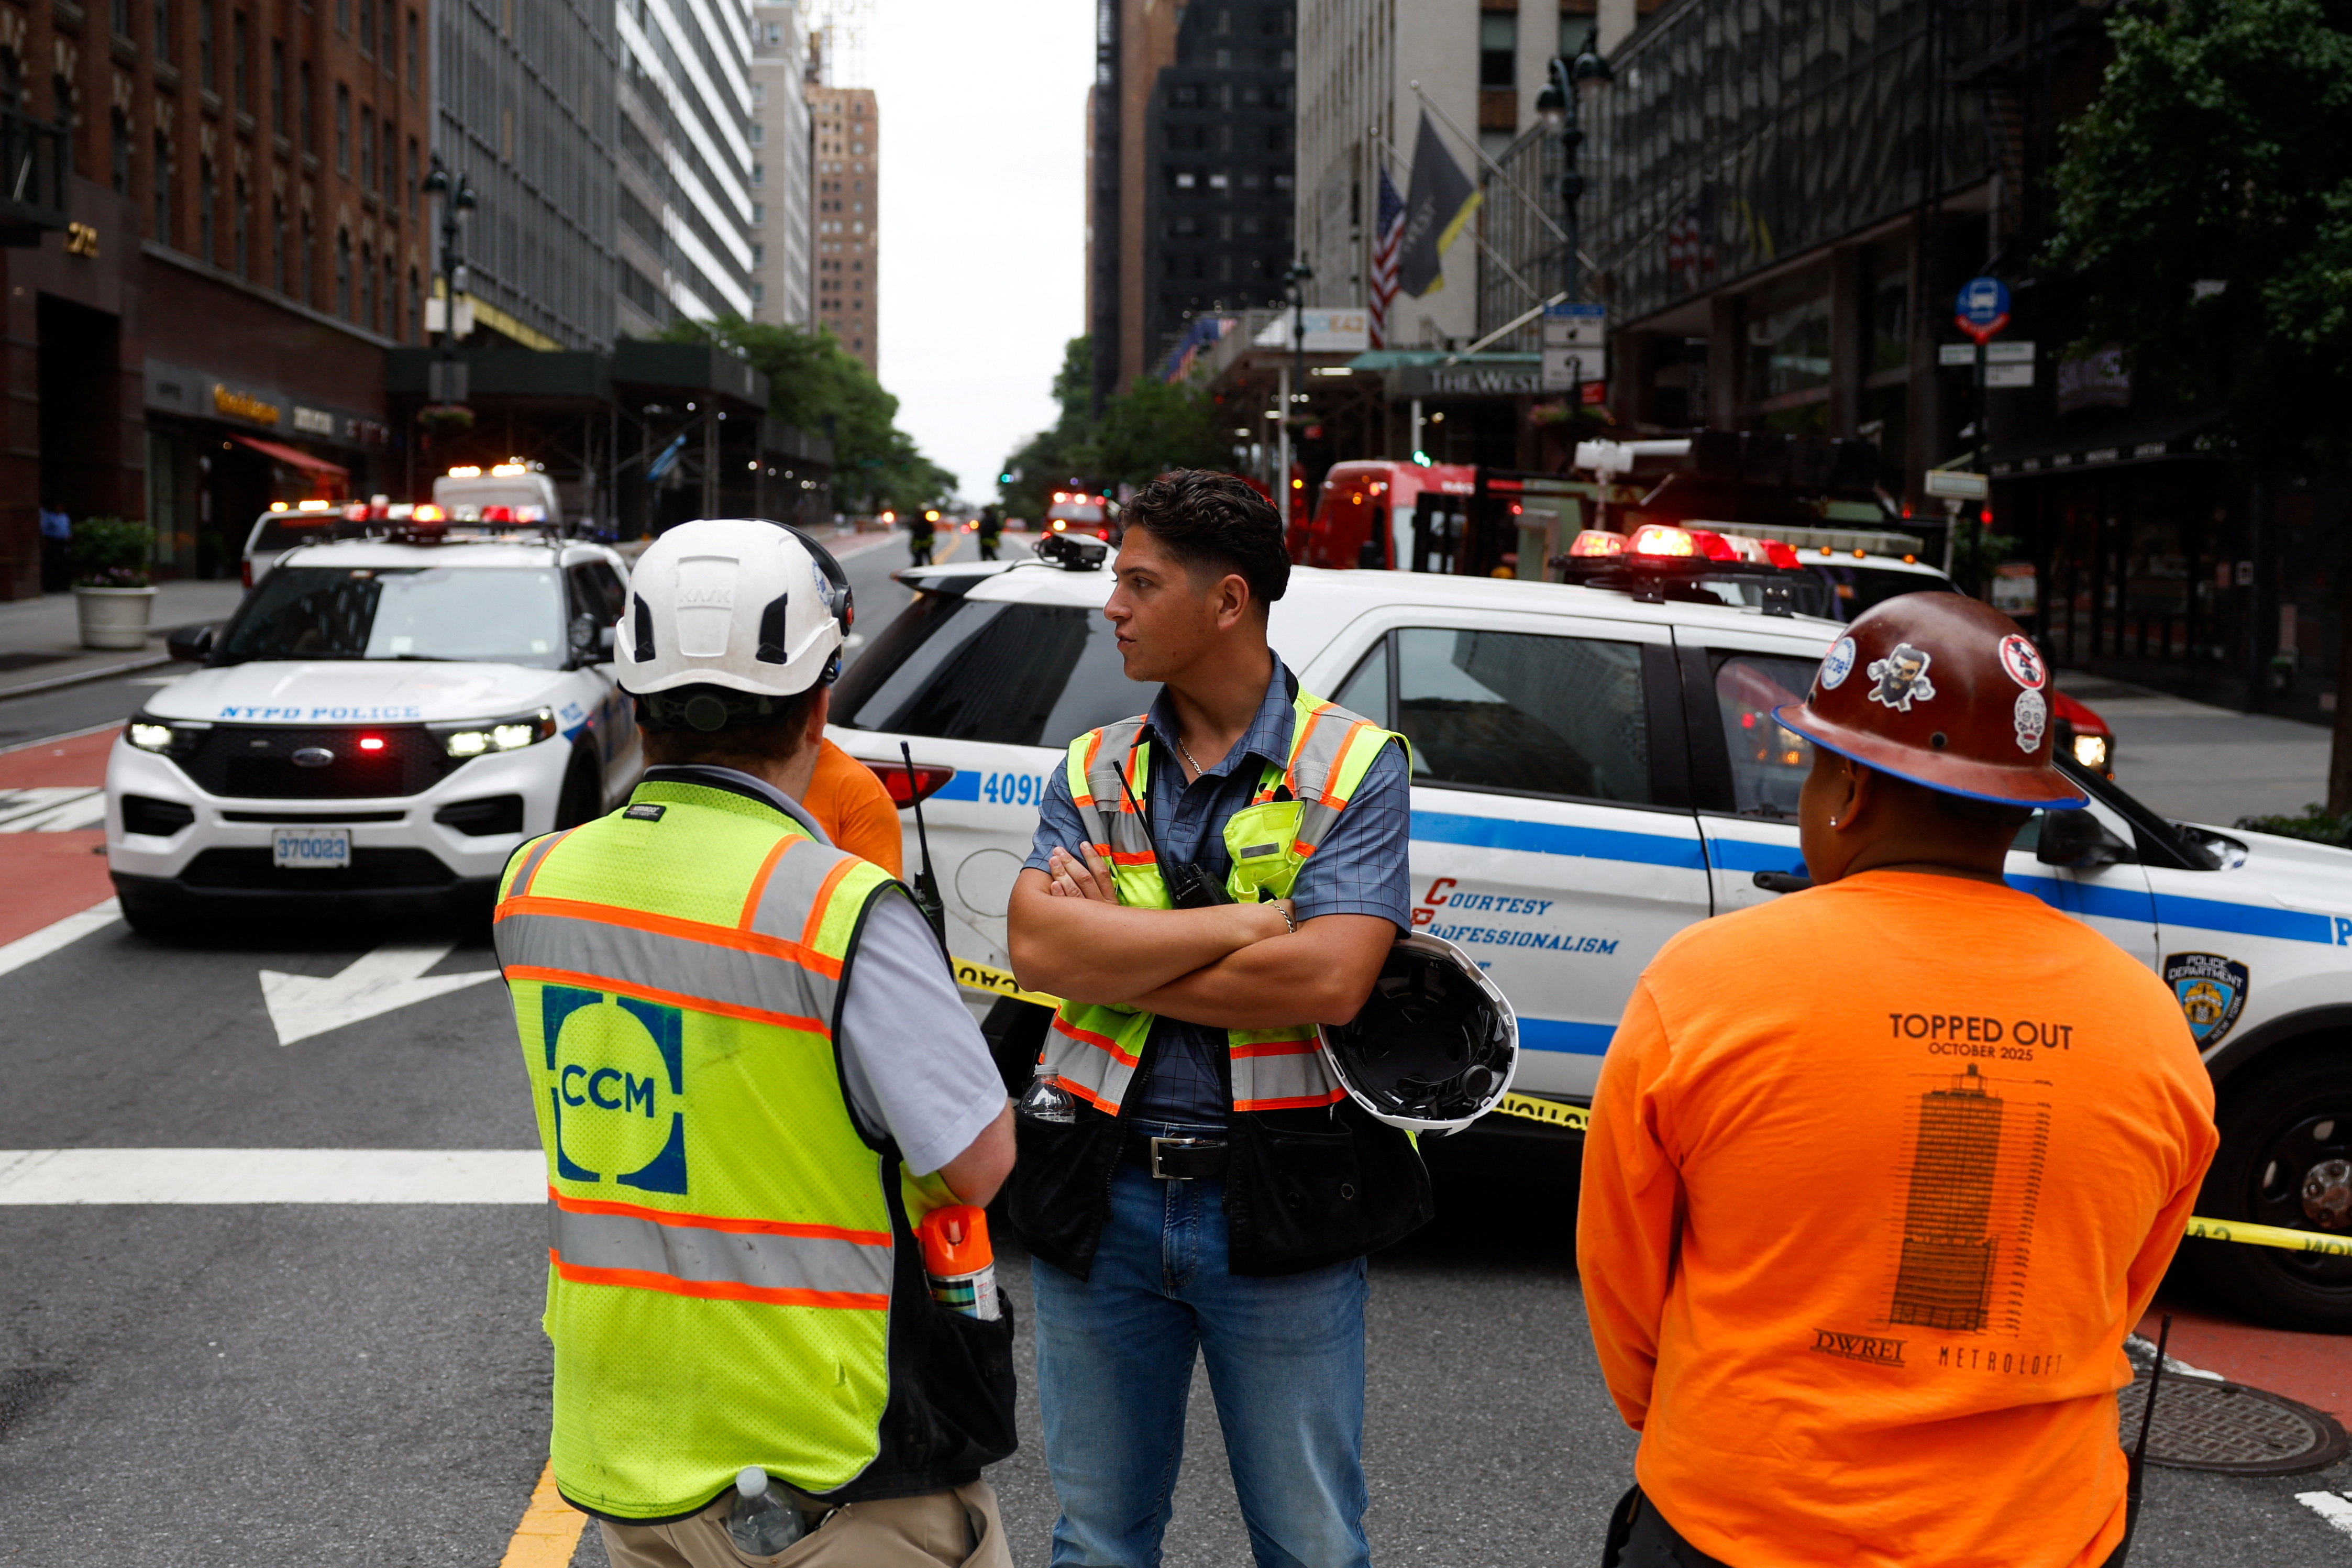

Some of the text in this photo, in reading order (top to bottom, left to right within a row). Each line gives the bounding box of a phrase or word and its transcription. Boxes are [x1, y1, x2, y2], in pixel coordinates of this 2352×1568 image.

[219, 705, 420, 719] NYPD POLICE
[985, 772, 1041, 805] 4091
[278, 839, 345, 858] 370023
[1181, 882, 1200, 896] MOTOROLA
[1424, 877, 1554, 915] COURTESY
[2186, 955, 2228, 969] POLICE
[2168, 966, 2244, 989] DEPARTMENT
[2211, 995, 2243, 1041] NEW YORK
[1889, 1013, 2073, 1050] TOPPED OUT
[1928, 1042, 2034, 1062] OCTOBER 2025
[561, 1064, 654, 1118] CCM
[1939, 1346, 2062, 1375] METROLOFT
